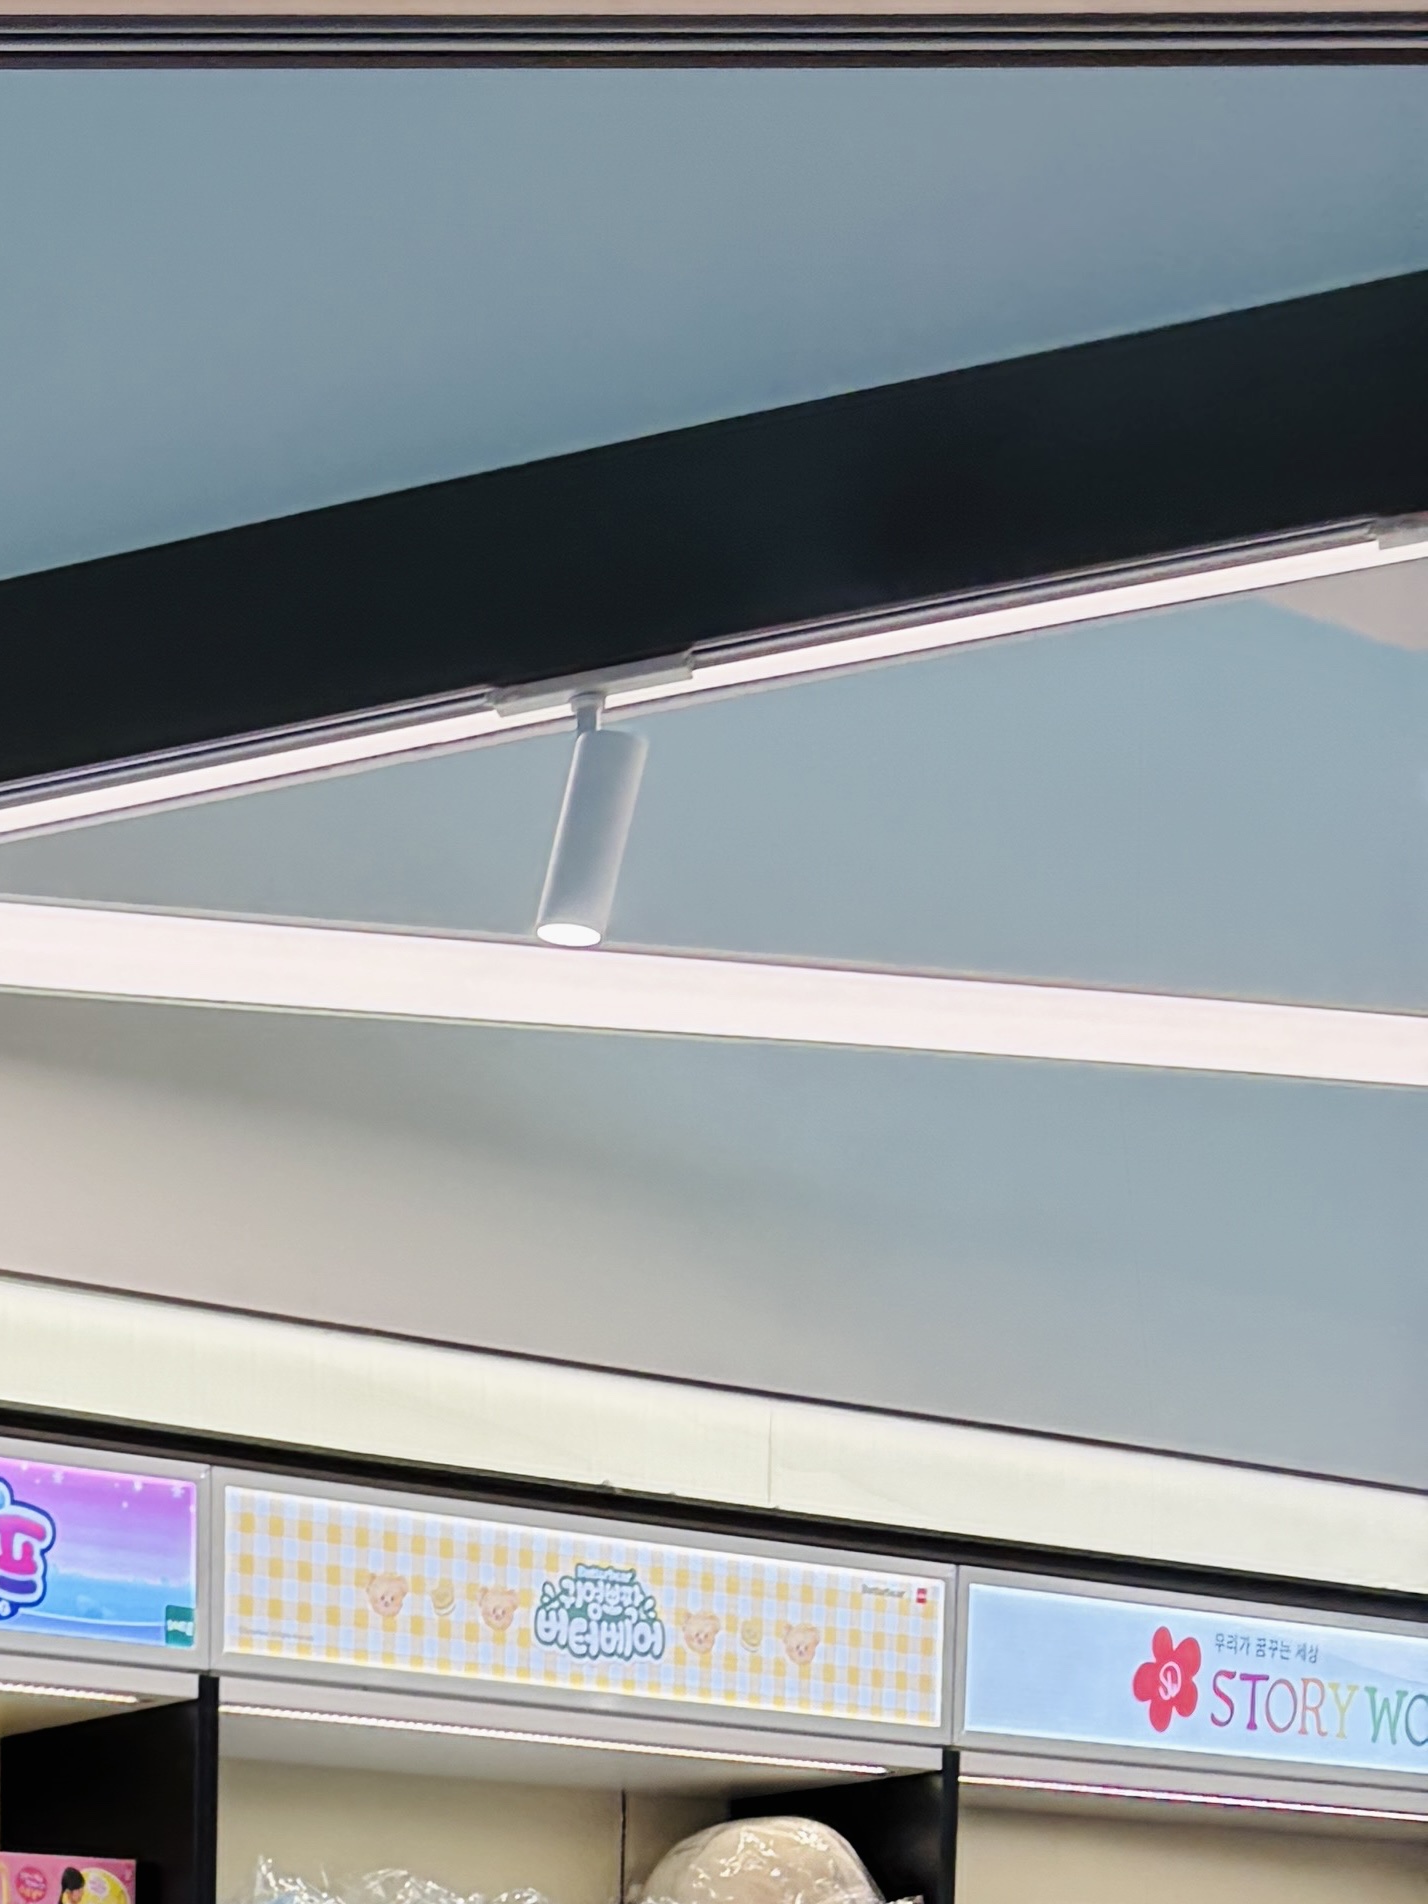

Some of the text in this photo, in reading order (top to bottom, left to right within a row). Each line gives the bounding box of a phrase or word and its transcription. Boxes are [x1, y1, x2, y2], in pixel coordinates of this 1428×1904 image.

[537, 1608, 664, 1659] 버터베어
[1214, 1632, 1319, 1665] 우리가 꿈꾸는 세상
[1211, 1670, 1358, 1740] STORY
